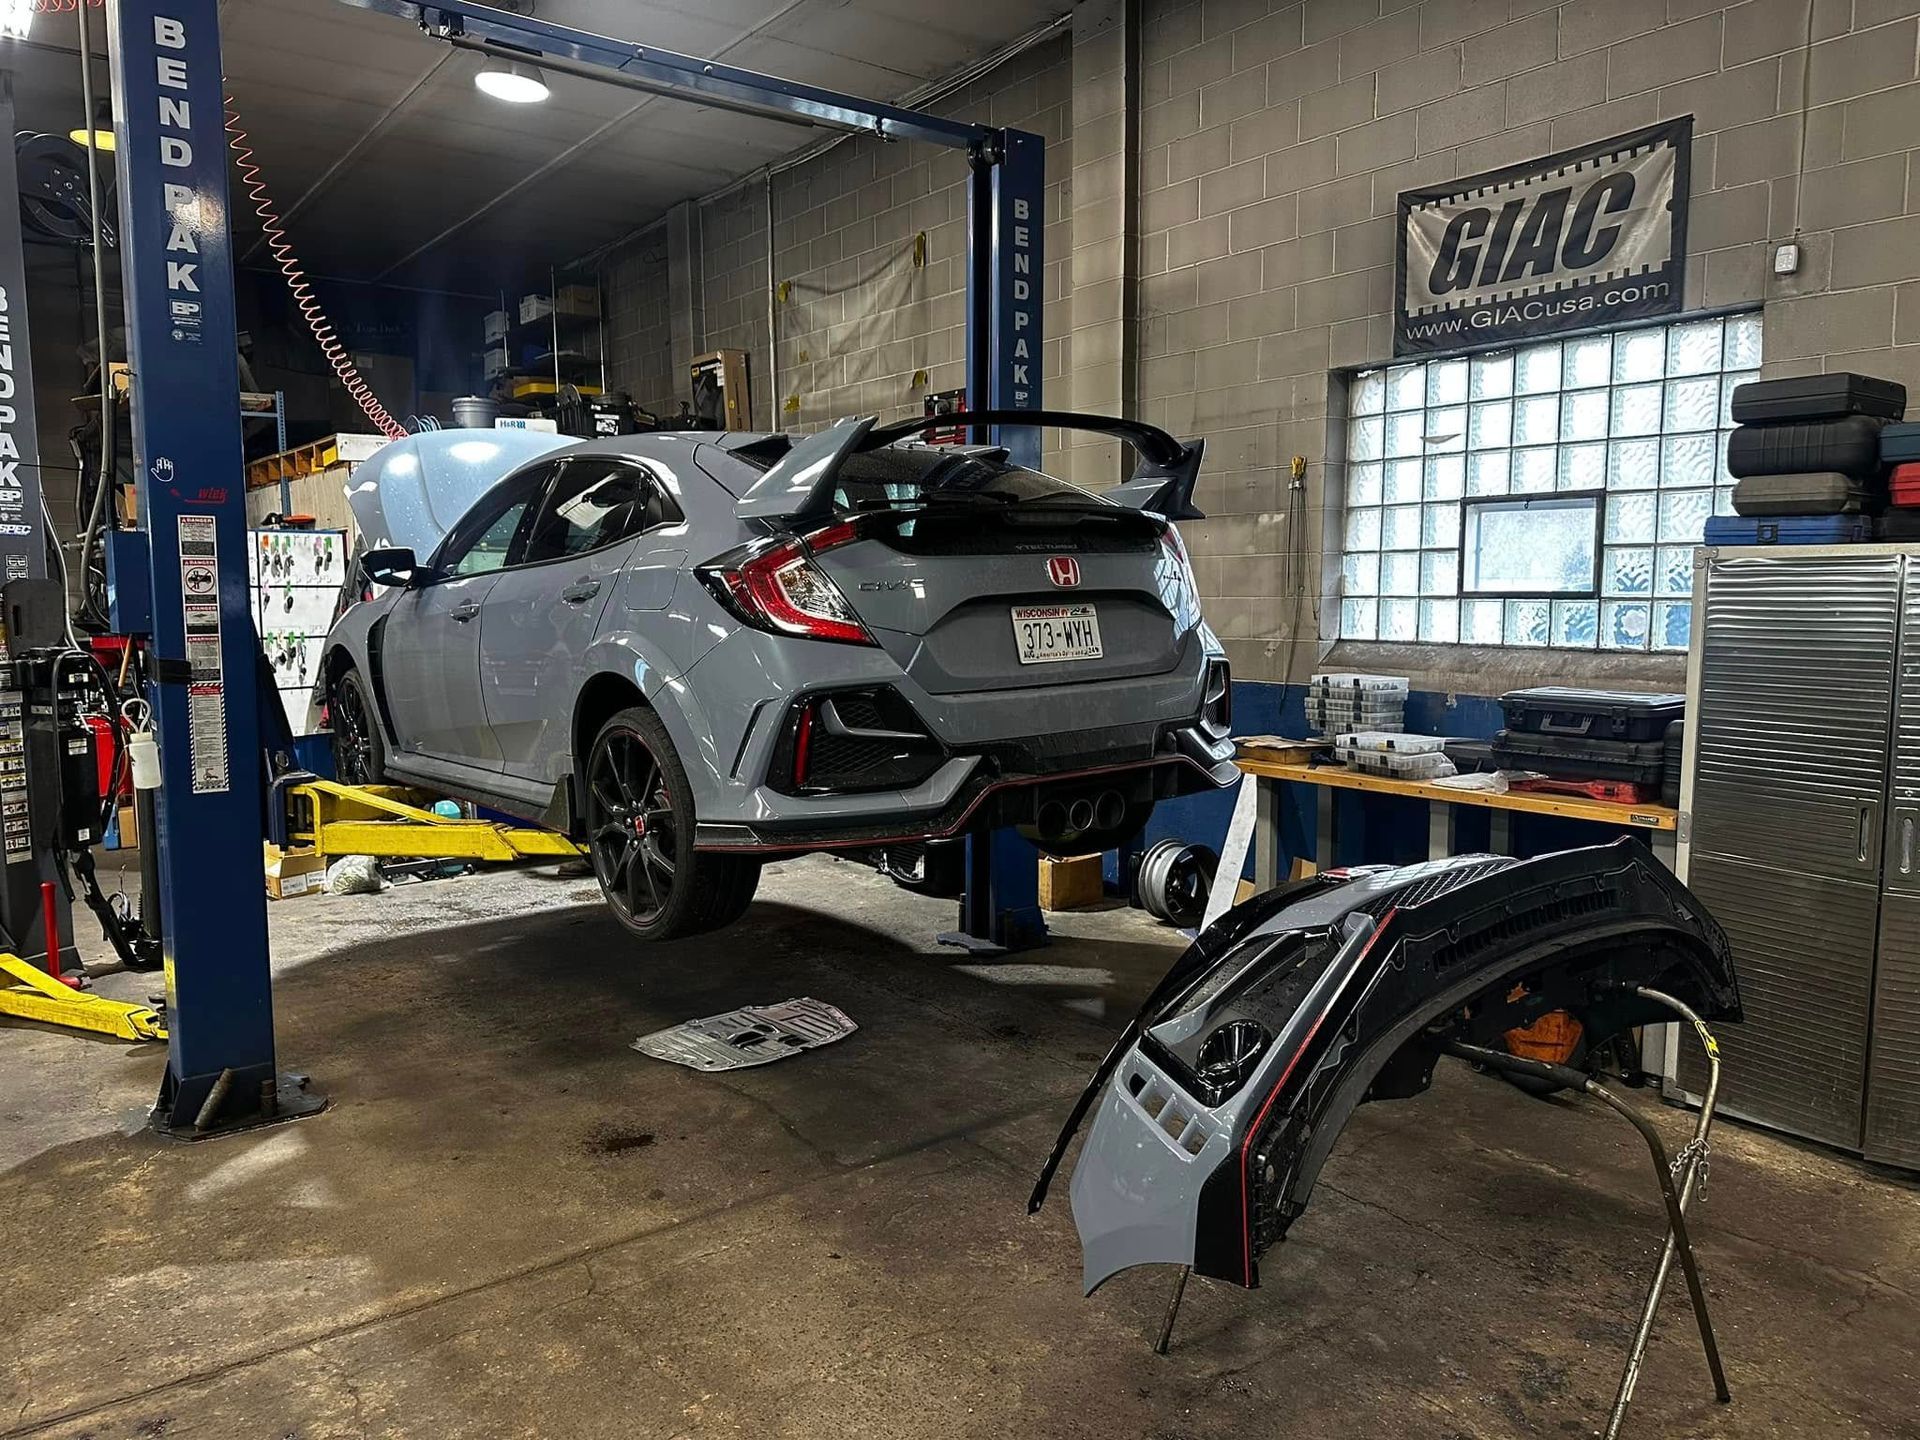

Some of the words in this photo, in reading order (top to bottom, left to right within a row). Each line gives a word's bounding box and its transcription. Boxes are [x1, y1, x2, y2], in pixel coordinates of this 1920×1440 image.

[1429, 171, 1636, 295] GIAC
[172, 301, 199, 315] BP
[1406, 281, 1670, 340] www.GIACusa.com
[1015, 607, 1060, 618] WISCONSIN
[1023, 620, 1094, 650] 373-WYH
